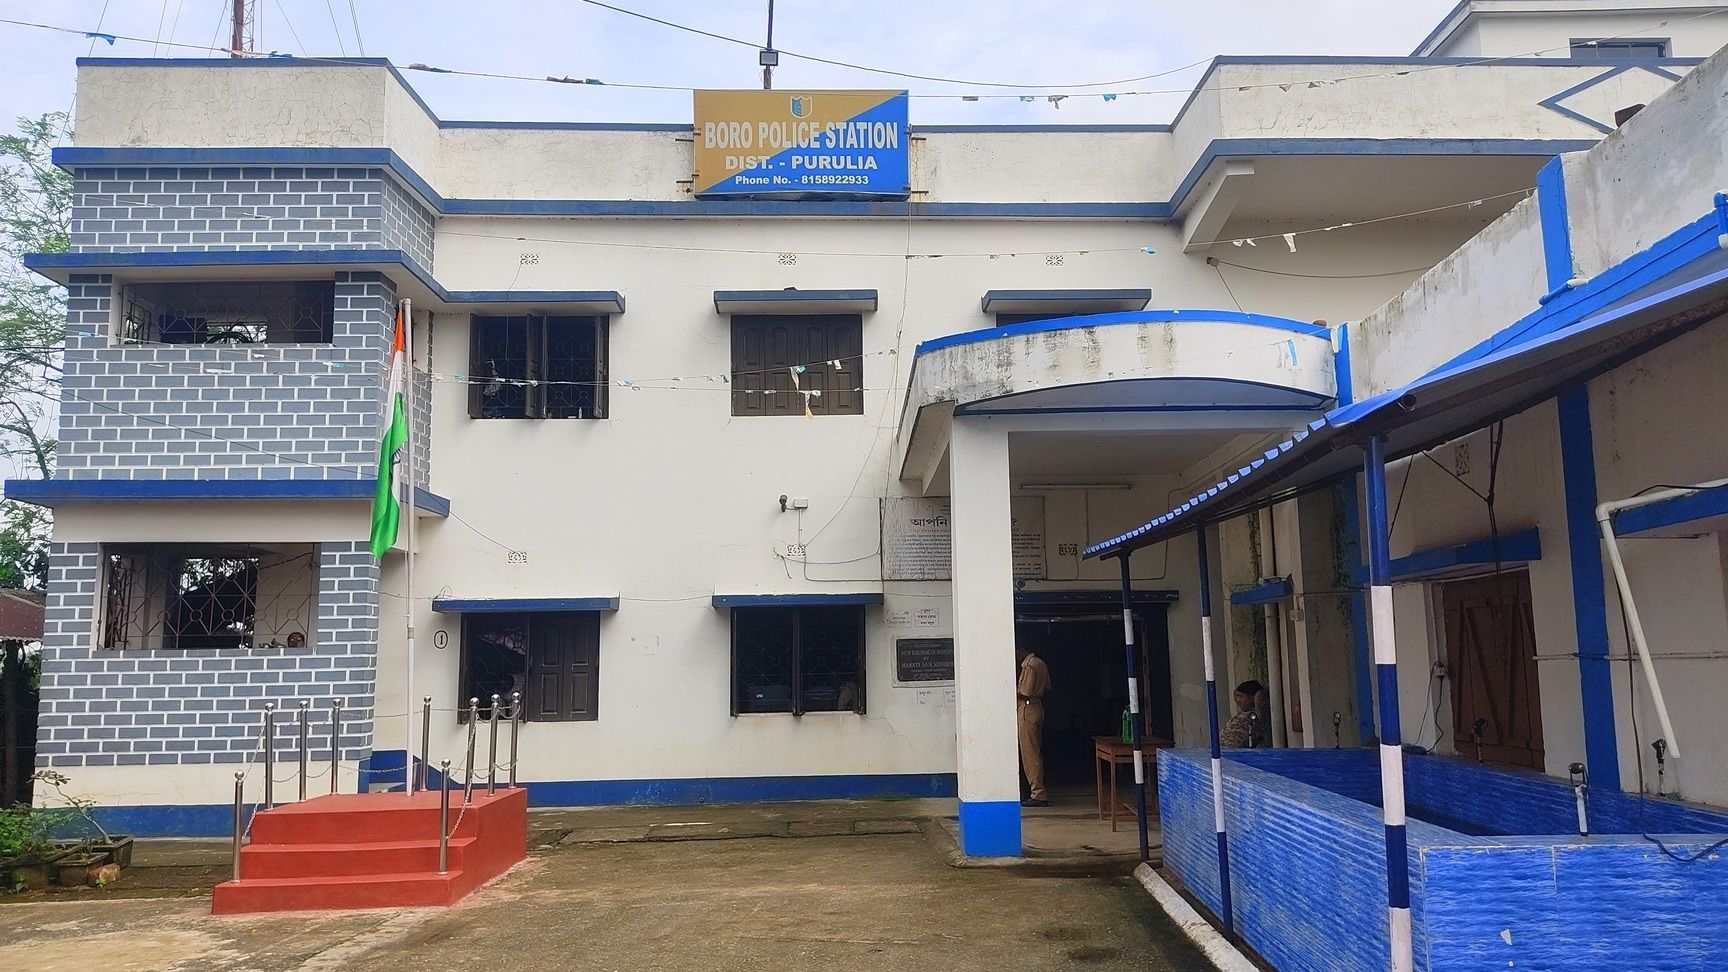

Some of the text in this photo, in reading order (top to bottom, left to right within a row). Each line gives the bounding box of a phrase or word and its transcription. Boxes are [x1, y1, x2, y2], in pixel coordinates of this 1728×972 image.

[705, 121, 898, 149] BORO POLICE STATION
[725, 155, 773, 170] DIST.
[791, 155, 878, 170] PURULIA
[735, 175, 770, 185] Phone
[773, 175, 792, 185] No.
[801, 175, 869, 185] 8158922933
[910, 515, 948, 527] আপনি
